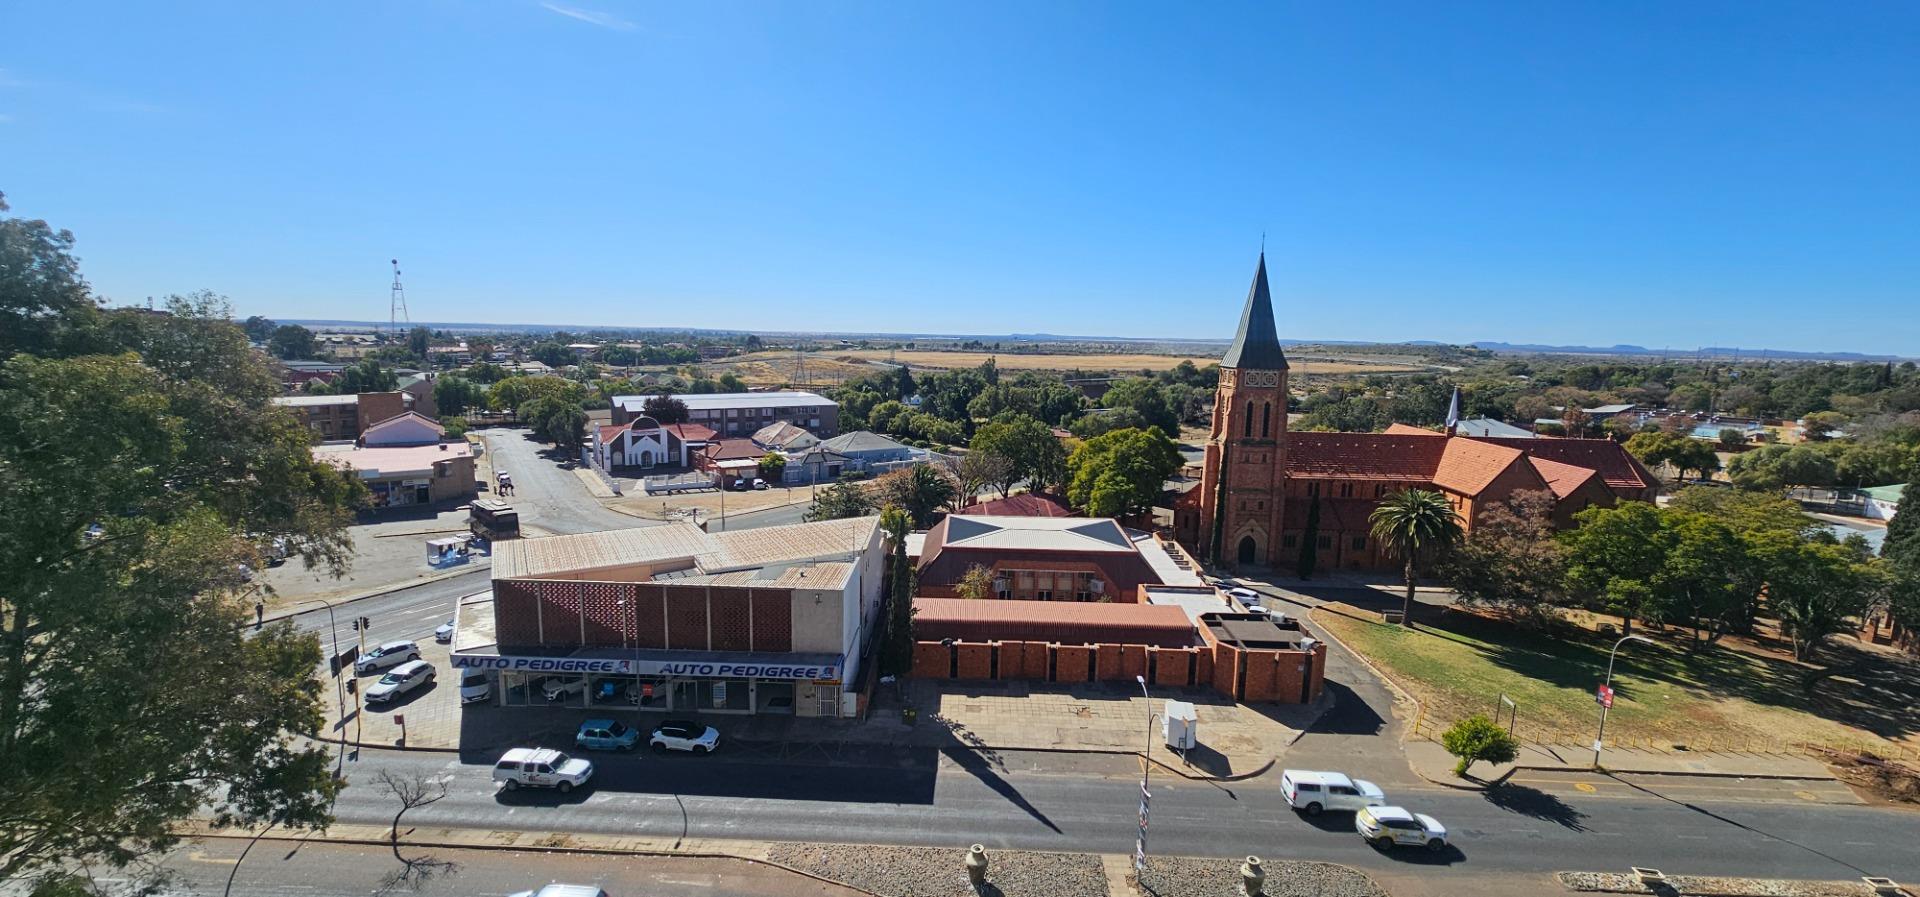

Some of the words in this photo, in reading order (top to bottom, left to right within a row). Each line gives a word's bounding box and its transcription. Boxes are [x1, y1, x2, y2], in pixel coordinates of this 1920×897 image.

[456, 657, 510, 669] AUTO
[514, 658, 614, 672] PEDIGREE
[659, 663, 714, 675] AUTO
[718, 665, 818, 678] PEDIGREE
